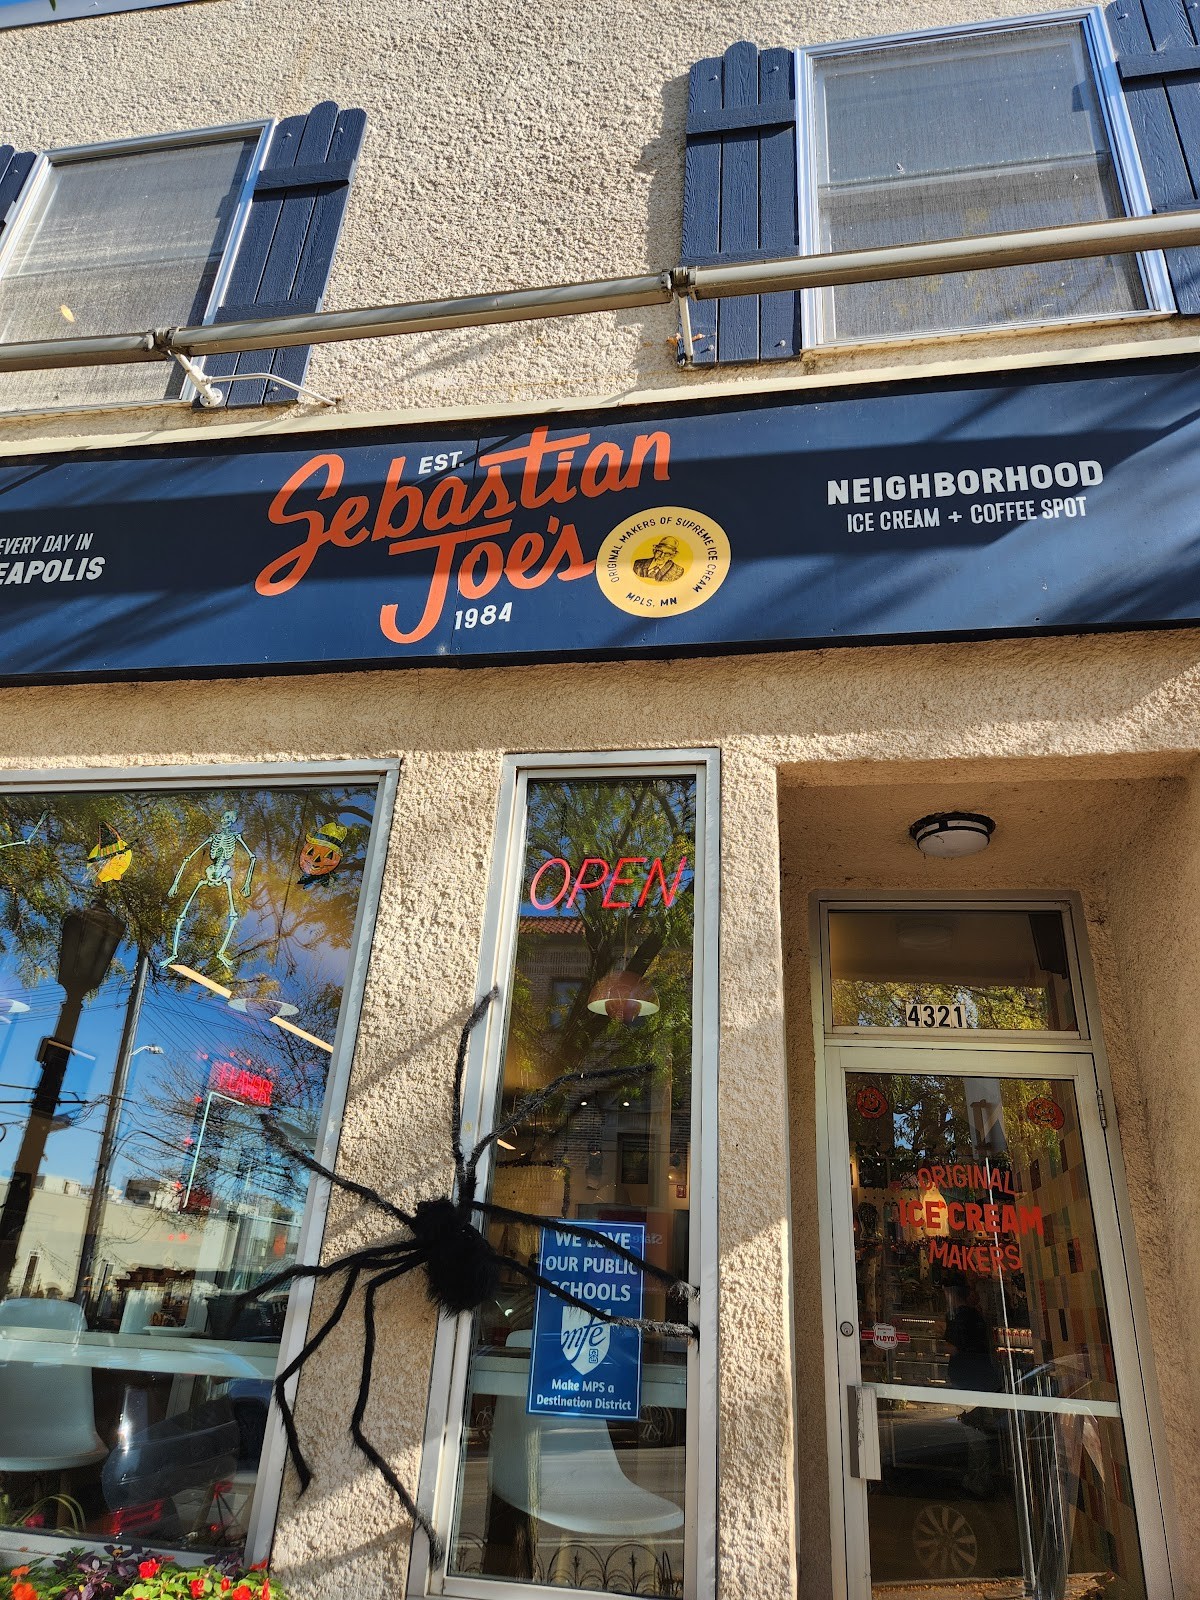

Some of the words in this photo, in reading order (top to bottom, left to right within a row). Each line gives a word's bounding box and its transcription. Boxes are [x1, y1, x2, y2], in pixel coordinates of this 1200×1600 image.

[418, 451, 465, 475] EST.
[827, 460, 1104, 505] NEIGHBORHOOD
[254, 426, 671, 597] Sebastian
[660, 516, 673, 525] OF
[847, 509, 874, 532] ICE
[880, 507, 940, 531] CREAM
[948, 509, 962, 524] +
[970, 501, 1037, 525] COFFEE
[1041, 496, 1088, 520] SPOT
[0, 536, 42, 555] EVERY
[42, 534, 75, 553] DAY
[75, 533, 94, 551] IN
[619, 519, 656, 544] MAKERS
[676, 517, 714, 546] SUPREME
[606, 545, 623, 583] ORIGINAL
[707, 547, 718, 561] ICE
[0, 556, 106, 585] EAPOLIS
[380, 516, 597, 644] Joe's
[692, 563, 717, 593] CREAM
[626, 592, 655, 608] MPLS.
[660, 597, 678, 607] MN
[454, 602, 513, 630] 1984
[530, 856, 687, 911] OPEN
[907, 1004, 963, 1028] 4321
[917, 1164, 1019, 1196] ORIGINAL
[900, 1200, 941, 1229] ICE
[948, 1202, 1044, 1236] CREAM
[556, 1230, 581, 1248] WE
[545, 1255, 578, 1272] OUR
[583, 1257, 638, 1275] PUBLIC
[928, 1241, 1022, 1272] MAKERS
[549, 1280, 631, 1302] SCHOOLS
[551, 1378, 579, 1392] Make
[582, 1380, 605, 1393] MPS
[608, 1383, 615, 1393] a
[536, 1394, 592, 1409] Destination
[595, 1397, 631, 1411] District
